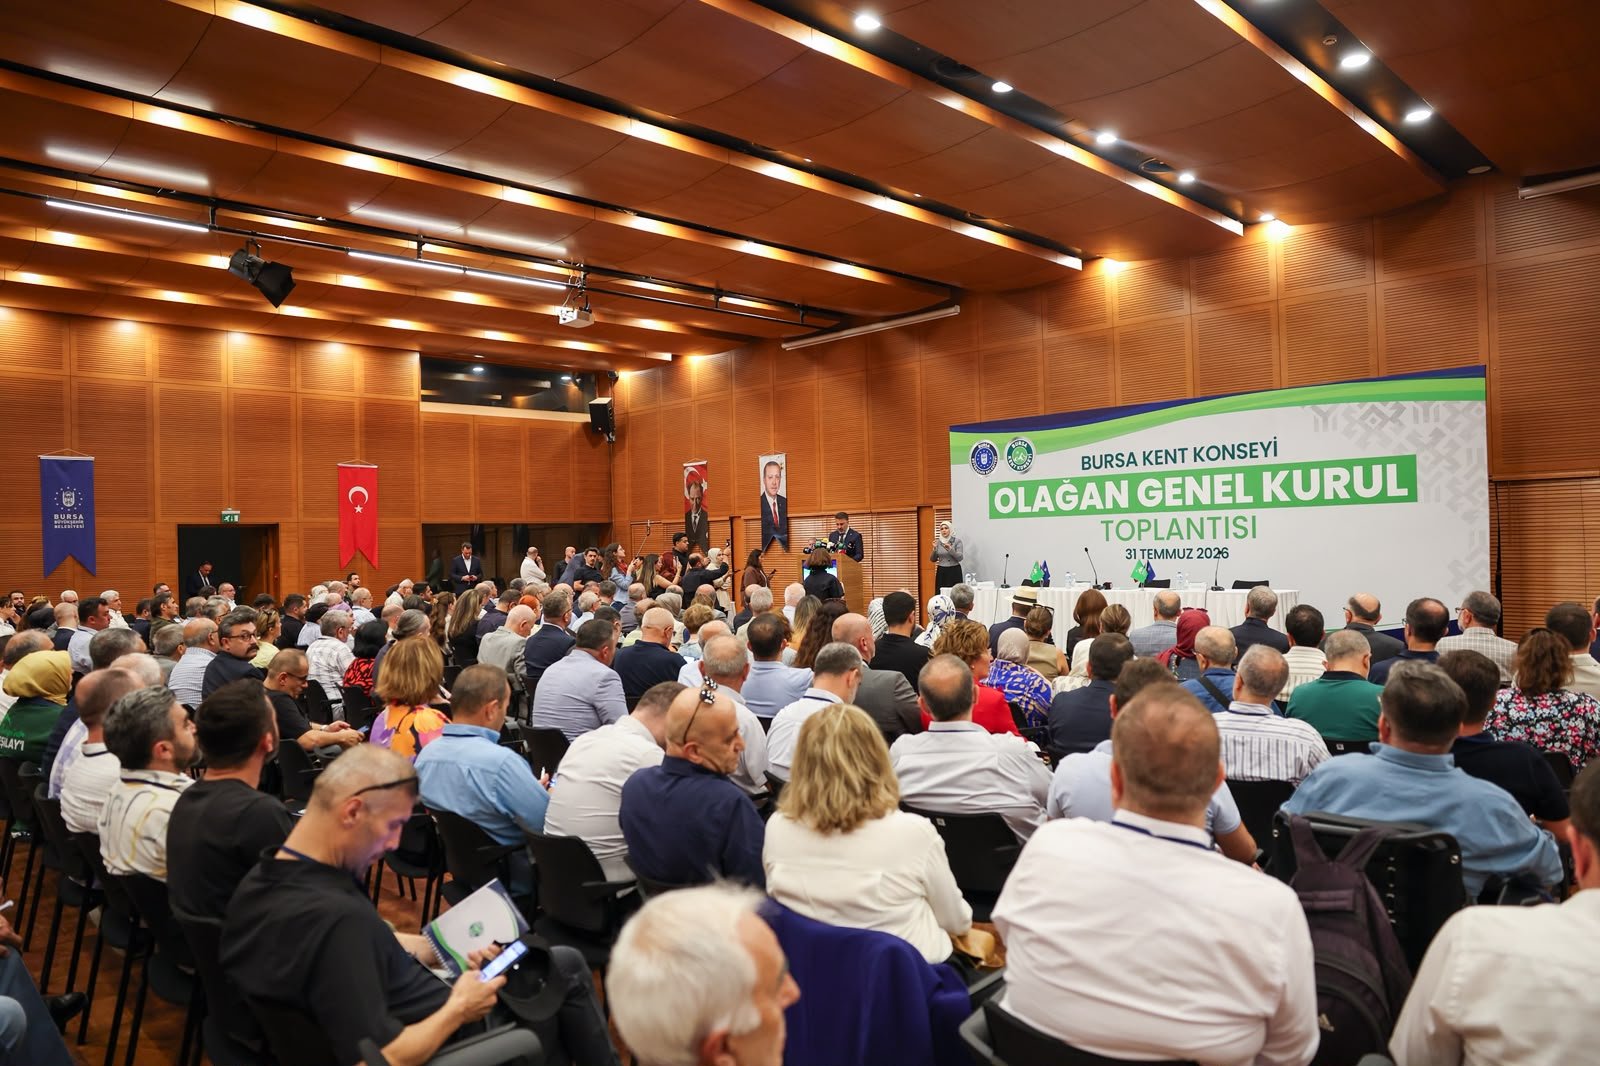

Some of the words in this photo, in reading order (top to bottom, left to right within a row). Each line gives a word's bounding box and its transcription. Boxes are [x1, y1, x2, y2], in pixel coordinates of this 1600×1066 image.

[1081, 451, 1138, 471] BURSA
[1142, 447, 1189, 466] KENT
[1193, 436, 1278, 463] KONSEYİ
[994, 479, 1129, 514] OLAĞAN
[1137, 472, 1254, 508] GENEL
[1262, 463, 1409, 502] KURUL
[1100, 515, 1257, 542] TOPLANTISI
[1125, 548, 1137, 560] 31
[1140, 547, 1194, 560] TEMMUZ
[1196, 546, 1230, 560] 2026
